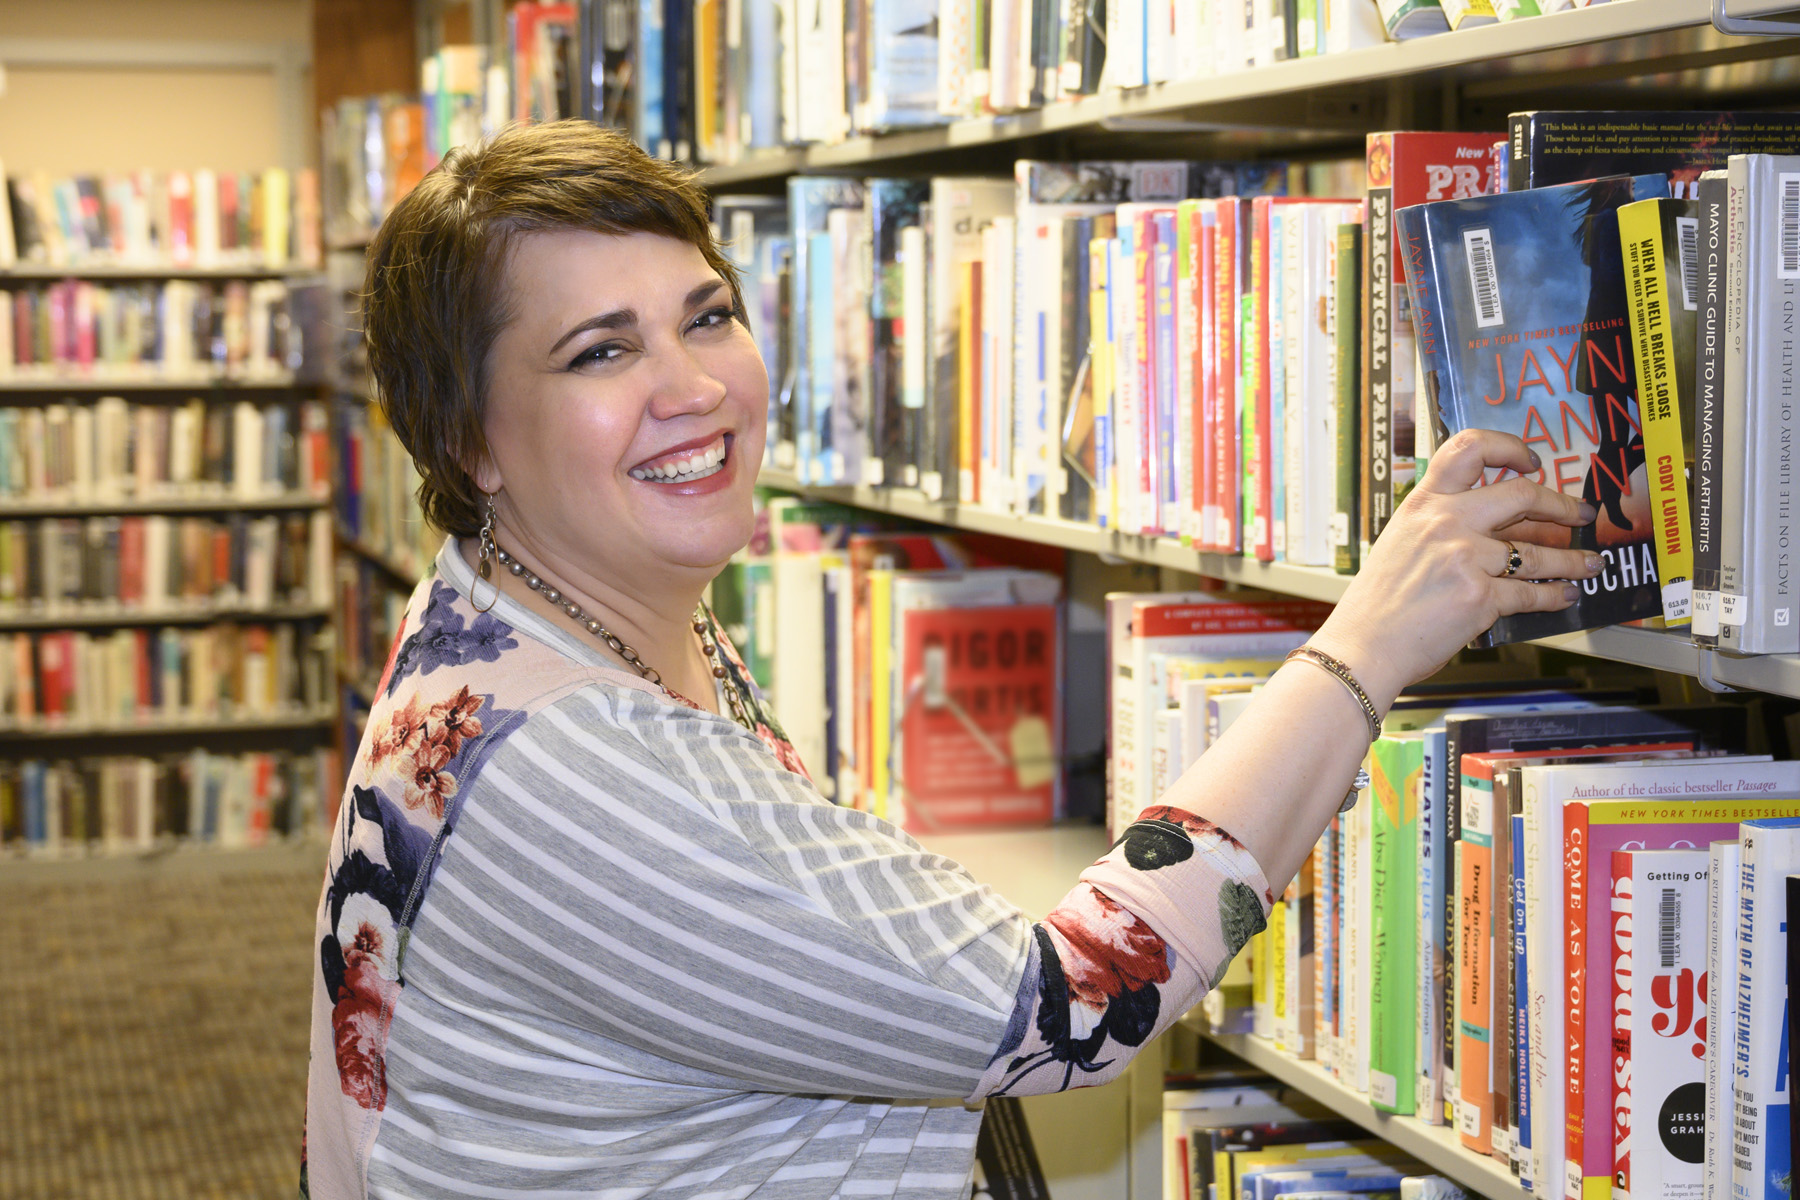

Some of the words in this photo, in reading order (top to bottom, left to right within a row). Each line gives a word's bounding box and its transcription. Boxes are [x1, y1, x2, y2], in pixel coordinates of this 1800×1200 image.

[1455, 146, 1484, 159] New
[1514, 124, 1523, 160] STEIN
[1708, 203, 1720, 249] MAYO
[1630, 242, 1638, 262] STUFF
[1640, 238, 1656, 273] WHEN
[1372, 197, 1387, 370] PRACTICAL
[1632, 264, 1640, 278] YOU
[1644, 276, 1658, 298] ALL
[1706, 253, 1718, 304] CLINIC
[1735, 220, 1744, 330] ENCYCLOPEDIA
[1407, 232, 1428, 298] JAYNE
[1418, 308, 1437, 354] ANN
[1492, 293, 1500, 308] LEA
[1633, 279, 1642, 297] NEED
[1636, 298, 1644, 308] TO
[1636, 308, 1646, 338] SURVIVE
[1647, 300, 1662, 331] HELL
[1705, 307, 1716, 356] GUIDE
[1784, 300, 1794, 334] AND
[1468, 338, 1490, 350] NEW
[1494, 332, 1520, 345] YORK
[1524, 327, 1555, 340] TIMES
[1558, 317, 1625, 336] BESTSELLING
[1640, 338, 1649, 358] WHEN
[1734, 336, 1741, 354] OF
[1650, 332, 1667, 380] BREAKS
[1704, 358, 1715, 381] TO
[1782, 340, 1793, 396] HEALTH
[1642, 360, 1653, 392] DISASTER
[1646, 392, 1656, 422] STRIKES
[1656, 382, 1672, 420] LOOSE
[1782, 402, 1792, 422] OF
[1372, 382, 1386, 482] PALEO
[1701, 384, 1714, 472] MANAGING
[1780, 426, 1791, 486] LIBRARY
[1658, 454, 1676, 492] CODY
[1700, 475, 1712, 553] ARTHRITIS
[1779, 491, 1790, 520] FILE
[1662, 498, 1682, 556] LUNDIN
[1778, 525, 1789, 548] ON
[1778, 553, 1789, 596] FACTS
[1668, 598, 1689, 609] 613.69
[1673, 608, 1686, 617] LUN
[1694, 602, 1712, 612] MAY
[1724, 606, 1733, 614] TAY
[1447, 740, 1456, 790] DAVID
[1572, 784, 1610, 798] Author
[1614, 783, 1627, 796] of
[1628, 782, 1646, 796] the
[1648, 781, 1682, 794] classic
[1684, 779, 1734, 794] bestseller
[1736, 779, 1778, 793] Passages
[1423, 755, 1432, 858] PILATES
[1447, 794, 1456, 838] KNOX
[1620, 810, 1647, 818] NEW
[1652, 809, 1685, 818] YORK
[1691, 808, 1728, 818] TIMES
[1374, 822, 1386, 864] Abs
[1472, 864, 1480, 904] Drug
[1570, 828, 1582, 910] COME
[1647, 870, 1690, 882] Getting
[1742, 862, 1756, 893] THE
[1374, 869, 1386, 913] Diet
[1422, 867, 1431, 920] PLUS
[1514, 878, 1526, 905] Get
[1445, 894, 1454, 958] BODY
[1675, 932, 1681, 941] 00
[1740, 896, 1754, 944] MYTH
[1516, 929, 1526, 956] Top
[1570, 920, 1582, 956] AS
[1374, 932, 1386, 1004] Women
[1472, 910, 1480, 1006] Information
[1738, 948, 1753, 969] OF
[1710, 970, 1718, 982] the
[1444, 960, 1454, 1050] SCHOOL
[1534, 991, 1546, 1020] Sex
[1570, 968, 1581, 1026] YOU
[1518, 1008, 1526, 1044] MEIKA
[1736, 972, 1752, 1078] ALZHEIMER'S
[1534, 1024, 1547, 1060] and
[1535, 1062, 1547, 1088] the
[1569, 1035, 1580, 1094] ARE
[1708, 1058, 1716, 1122] CAREGIVER
[1744, 1092, 1754, 1103] YOU
[1740, 1119, 1756, 1130] ABOUT
[1742, 1106, 1758, 1118] BEING
[1708, 1131, 1716, 1144] Dr.
[1743, 1133, 1760, 1145] MOST
[1708, 1148, 1716, 1168] Ruth
